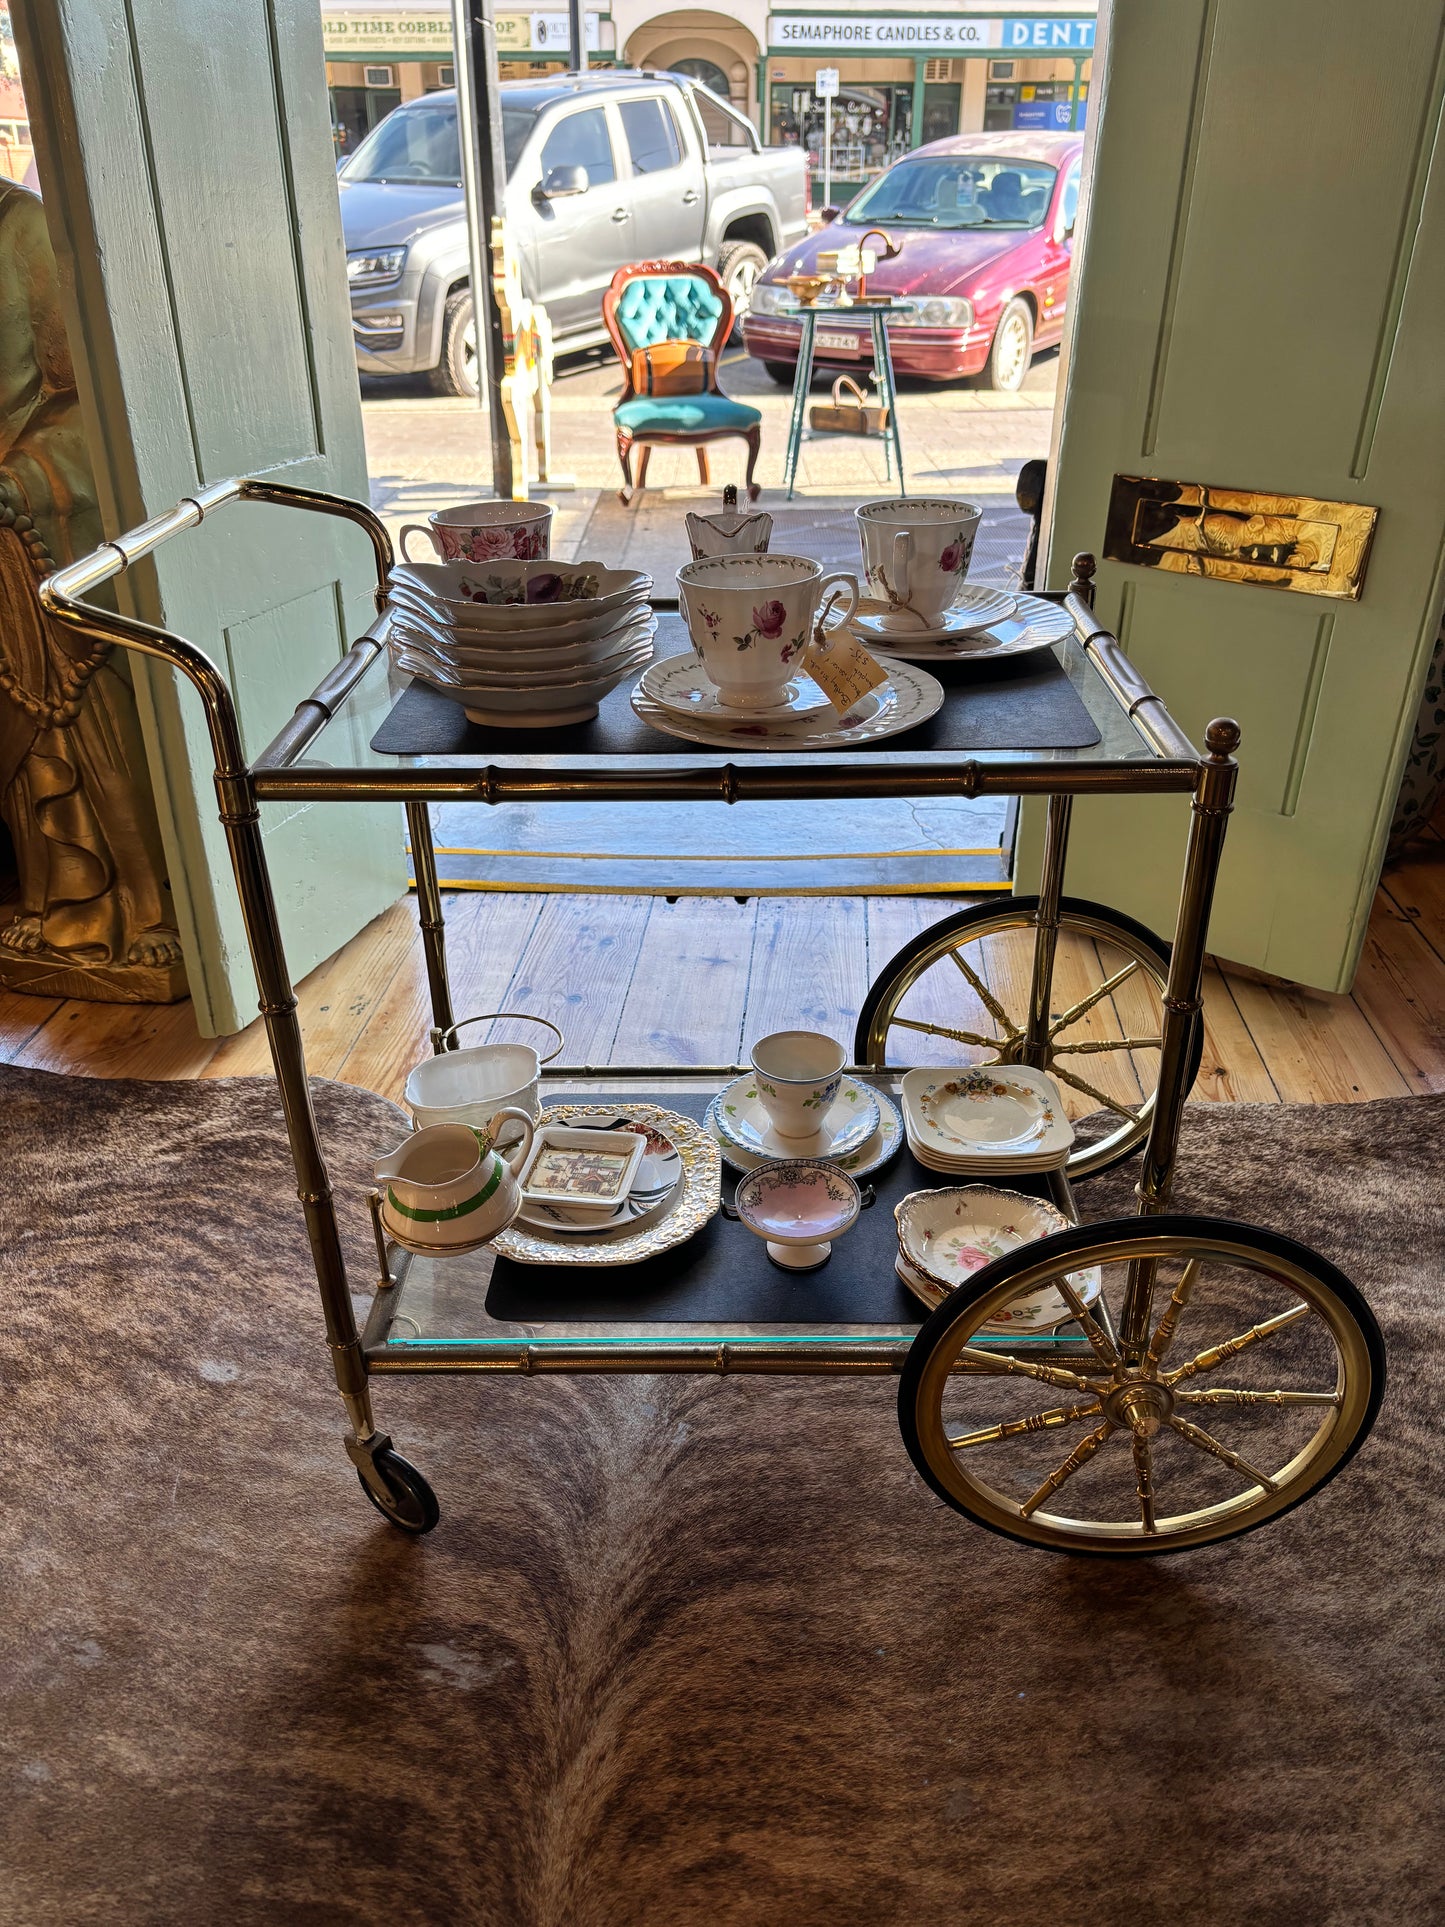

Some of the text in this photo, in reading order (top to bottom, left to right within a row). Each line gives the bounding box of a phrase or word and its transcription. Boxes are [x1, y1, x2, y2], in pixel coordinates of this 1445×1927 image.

[351, 22, 395, 33] TIME
[781, 24, 980, 41] SEMAPHORE CANDLES & CO.
[1012, 22, 1093, 46] DENT
